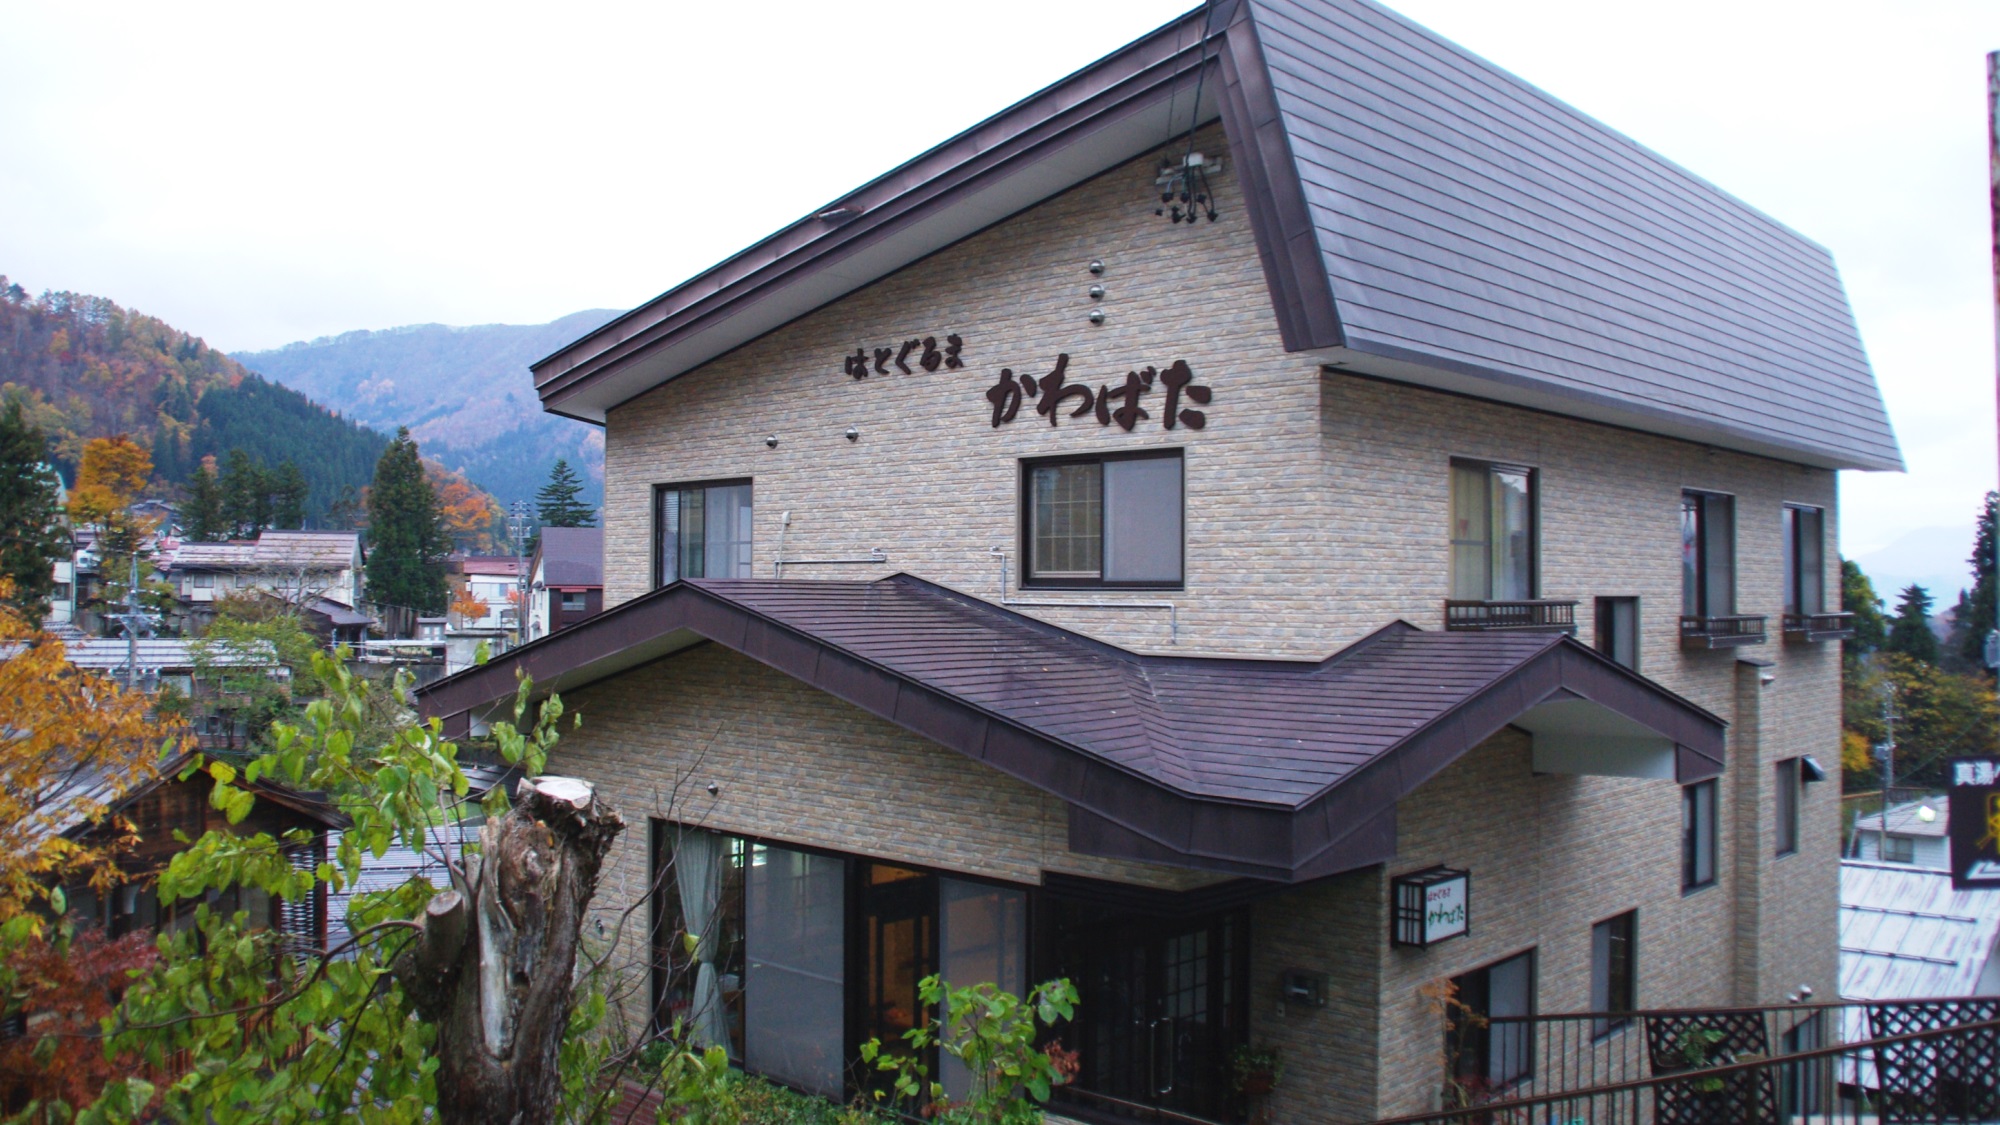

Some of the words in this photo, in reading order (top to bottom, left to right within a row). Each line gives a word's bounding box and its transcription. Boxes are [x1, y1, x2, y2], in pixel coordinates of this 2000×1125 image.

[844, 333, 964, 379] はとぐるま
[986, 353, 1212, 431] かわばた
